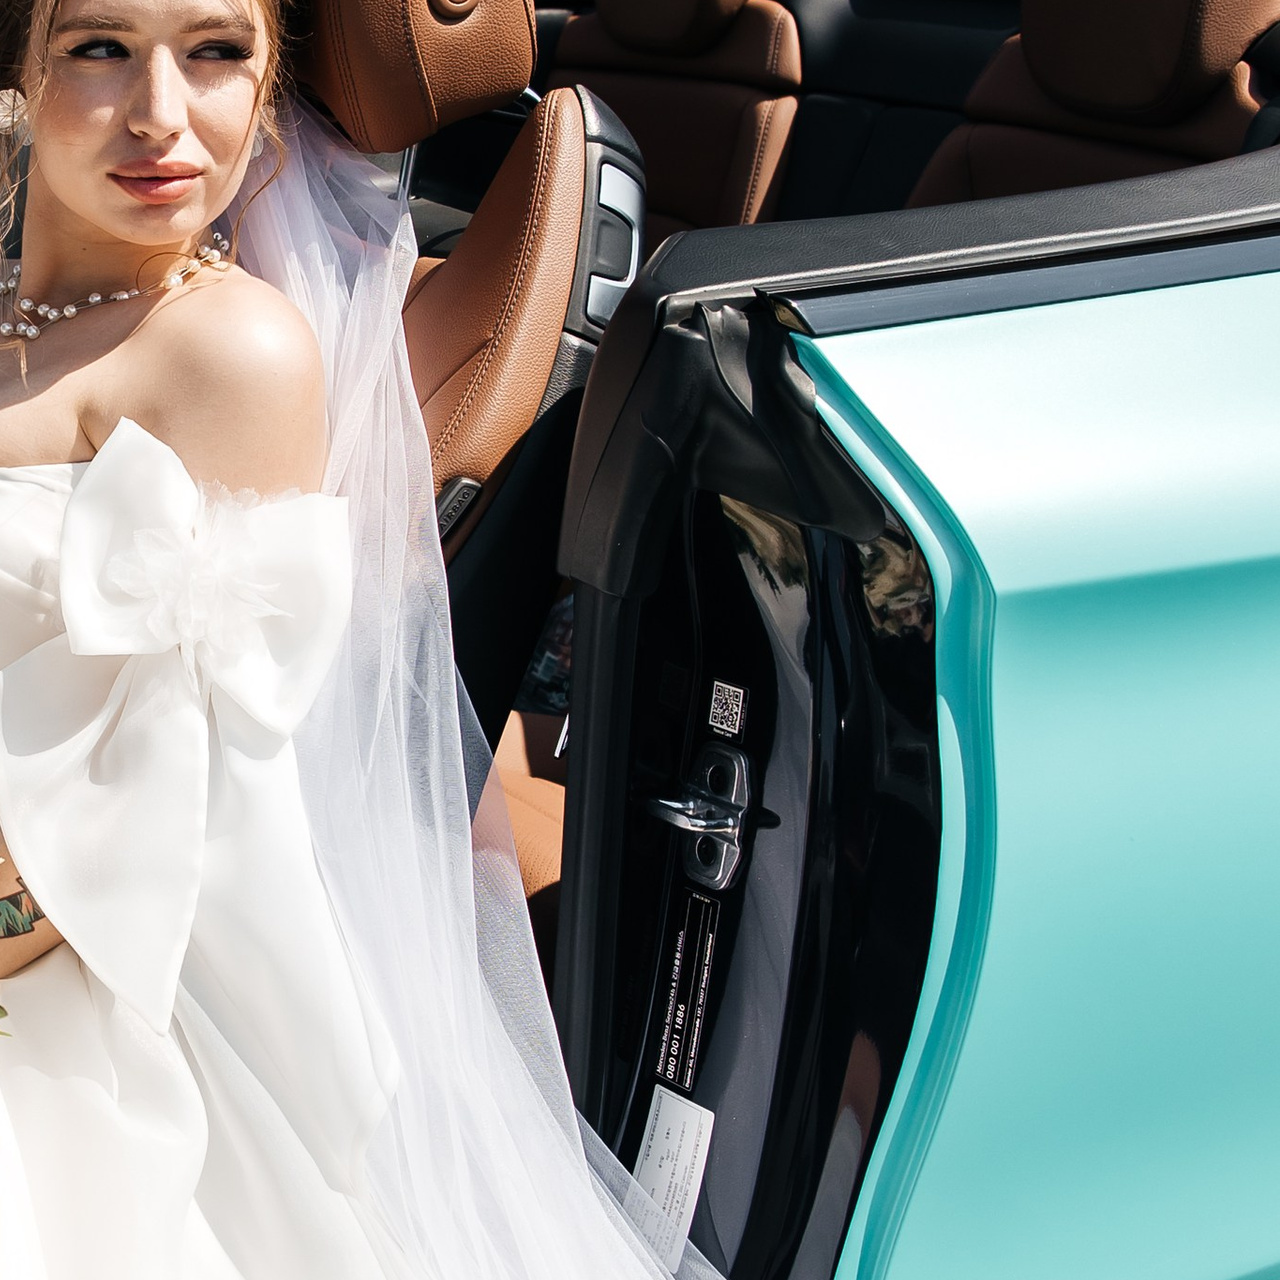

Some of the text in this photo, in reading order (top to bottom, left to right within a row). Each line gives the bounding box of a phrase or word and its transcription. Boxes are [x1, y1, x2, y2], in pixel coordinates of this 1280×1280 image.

[438, 489, 470, 531] AIRBAG
[666, 1004, 685, 1079] 080 001 1886
